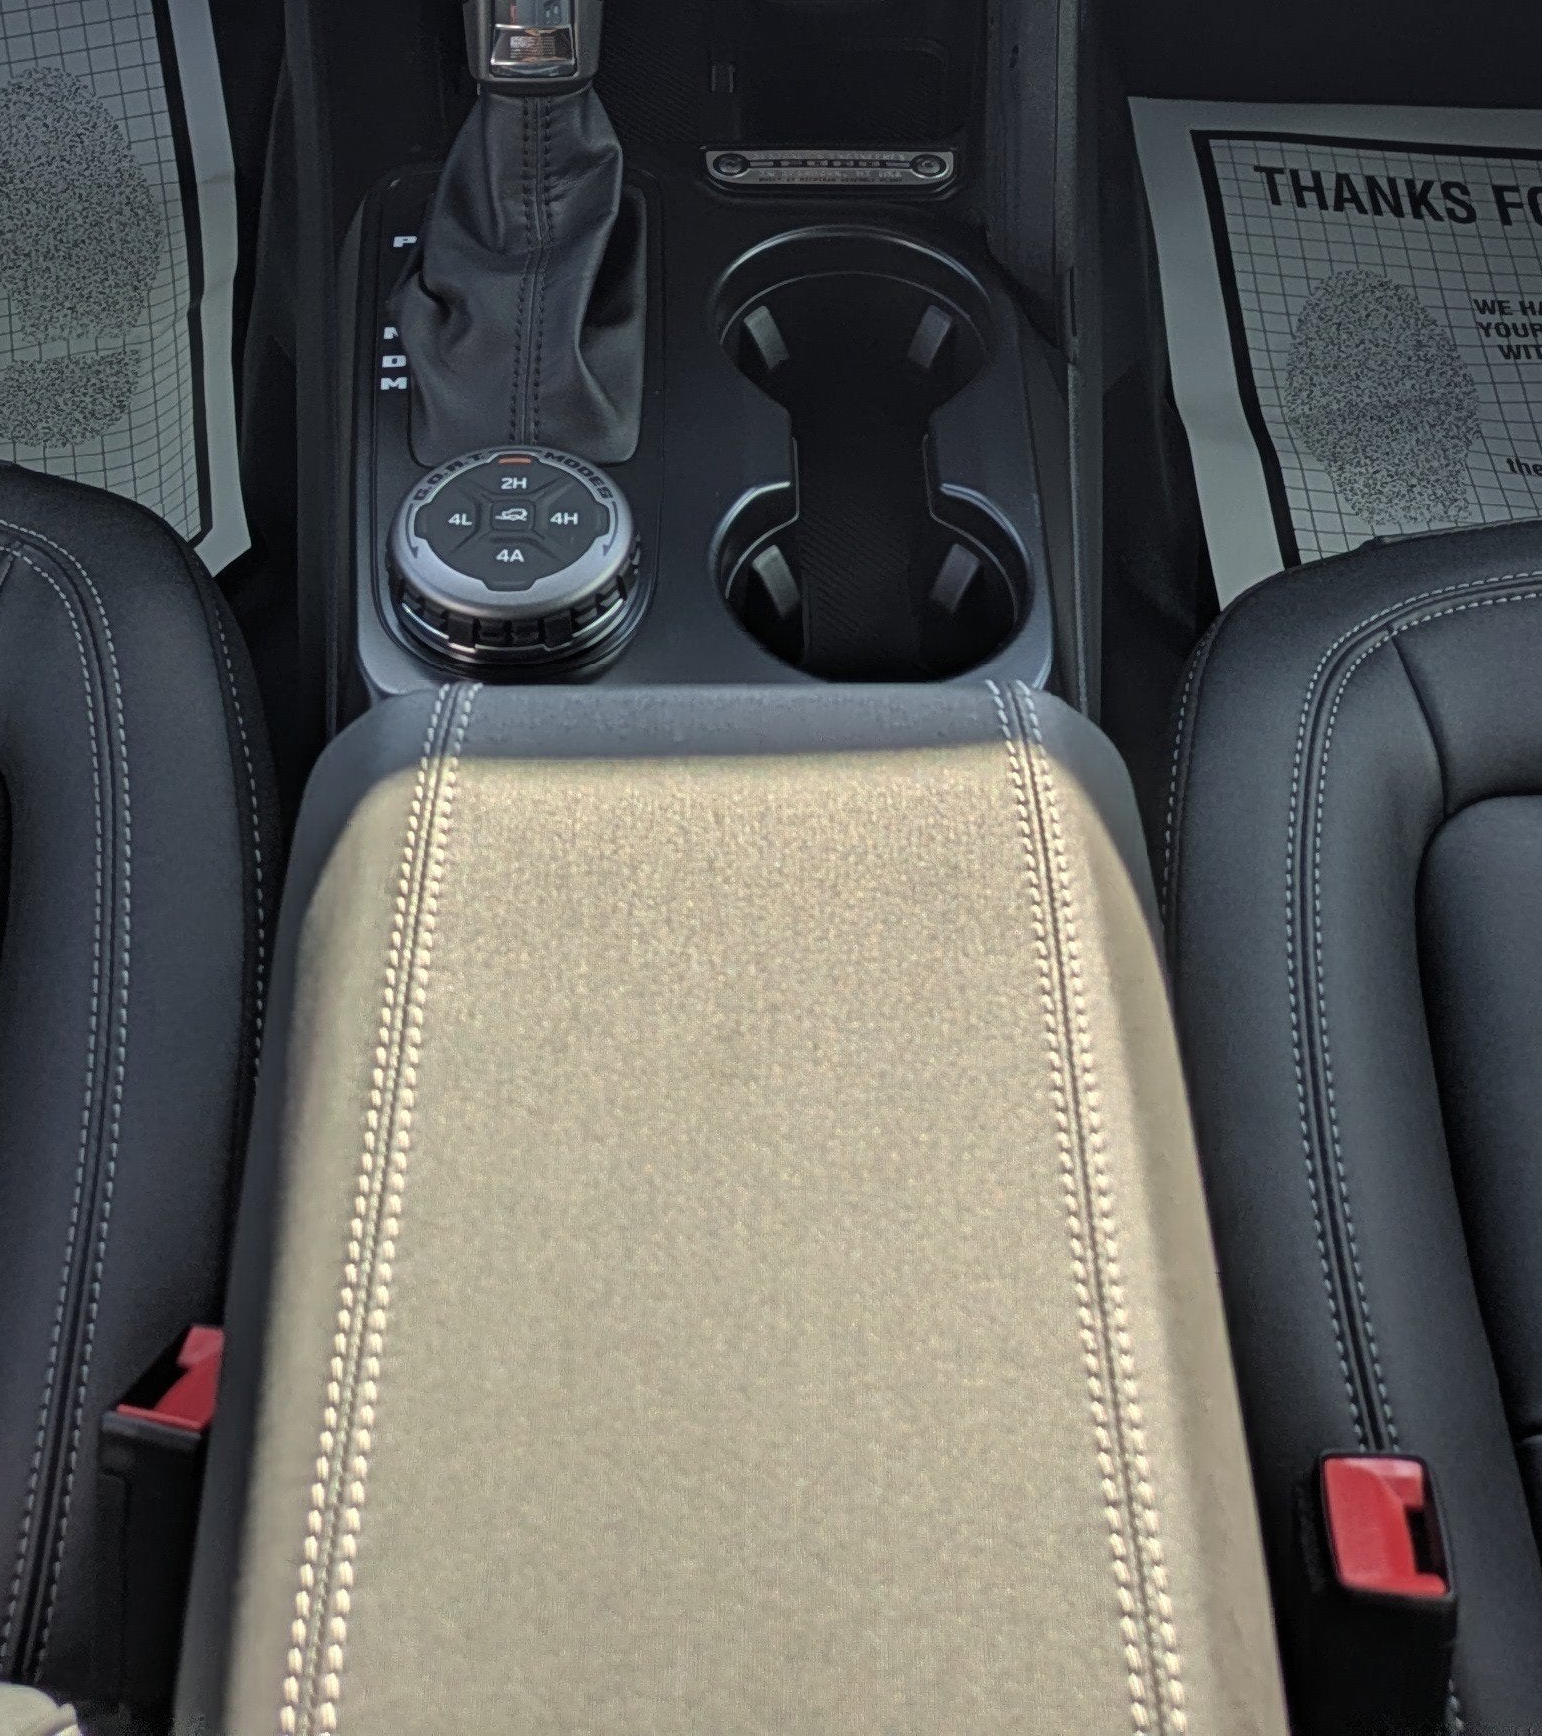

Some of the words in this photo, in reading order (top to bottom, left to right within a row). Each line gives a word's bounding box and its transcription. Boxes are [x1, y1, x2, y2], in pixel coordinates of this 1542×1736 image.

[1253, 165, 1477, 225] THANKS
[393, 235, 418, 248] P
[1473, 298, 1510, 316] WE
[382, 355, 407, 368] D
[380, 377, 408, 390] M
[544, 451, 614, 500] MODES
[501, 477, 527, 490] 2H
[448, 513, 472, 526] 4L
[550, 512, 579, 525] 4H
[496, 549, 525, 563] 4A
